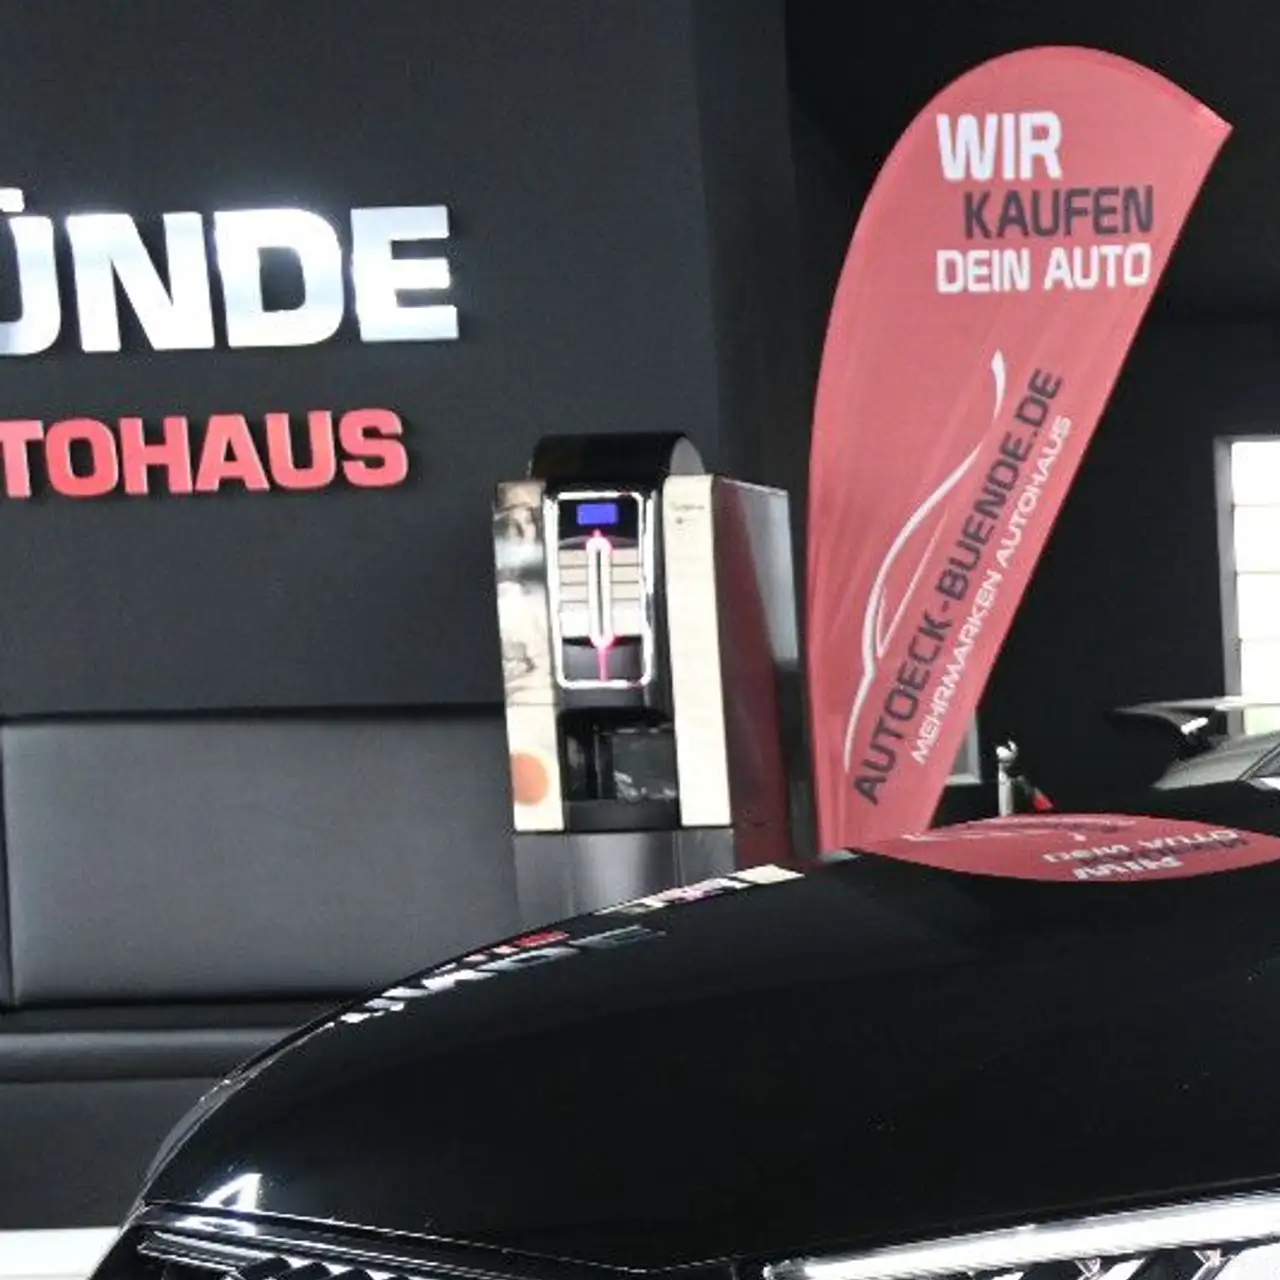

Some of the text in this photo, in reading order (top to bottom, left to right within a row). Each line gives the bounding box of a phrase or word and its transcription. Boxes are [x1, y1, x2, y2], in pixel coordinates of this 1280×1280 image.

[936, 110, 1063, 181] WIR
[964, 184, 1154, 240] KAUFEN
[936, 242, 1152, 294] DEIN AUTO
[0, 408, 409, 498] TOHAUS
[853, 368, 1062, 806] AUTOECK-BUENDE.DE
[911, 414, 1072, 764] MEHRMARKEN AUTOHAUS
